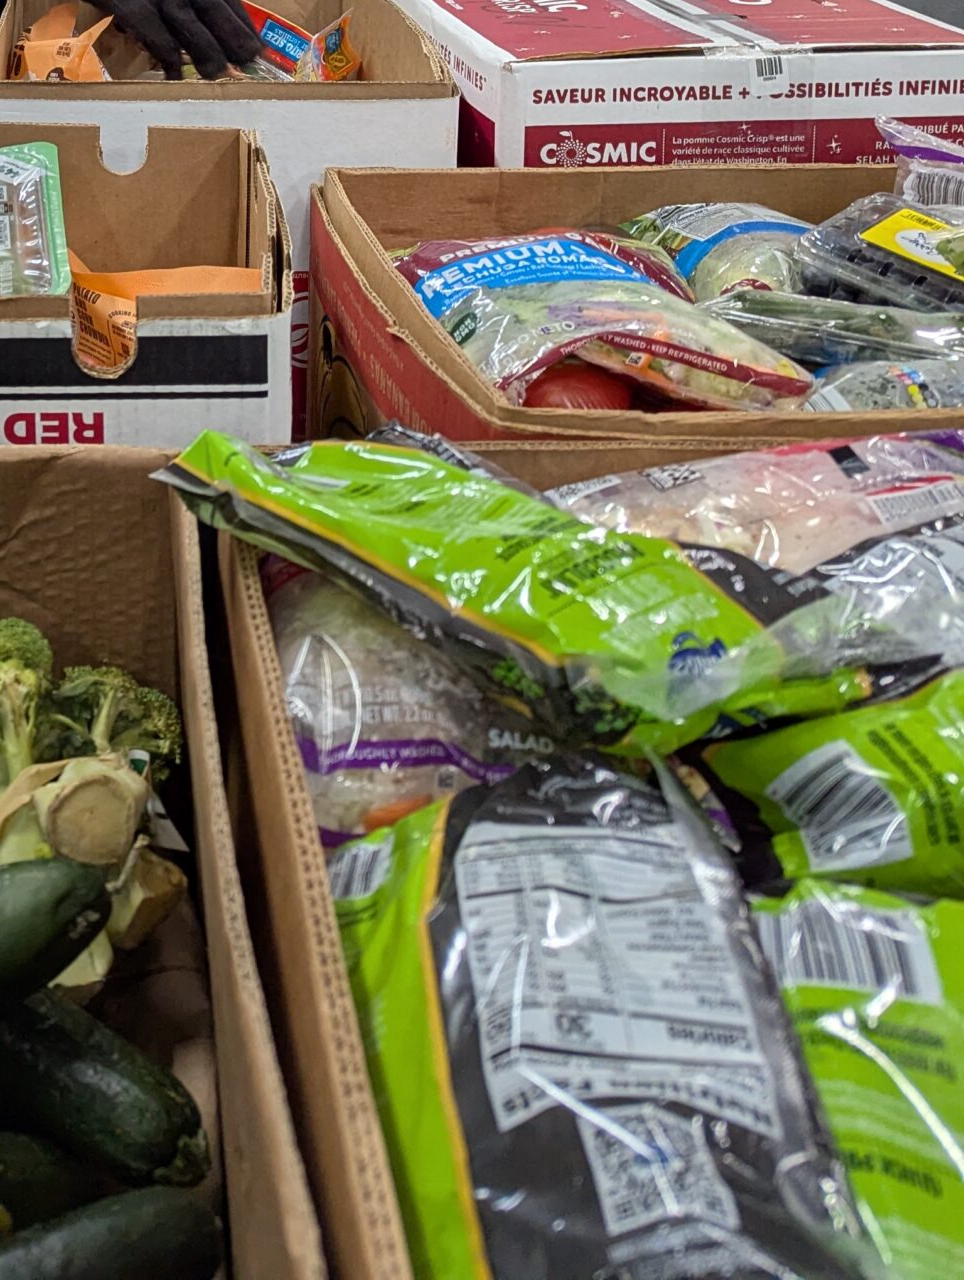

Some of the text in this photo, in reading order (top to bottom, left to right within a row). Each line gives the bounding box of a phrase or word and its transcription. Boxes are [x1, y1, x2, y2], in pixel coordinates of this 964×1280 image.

[265, 31, 286, 48] SIZE
[532, 87, 607, 105] SAVEUR
[611, 85, 733, 103] INCROYABLE
[756, 78, 893, 100] SSIBILITIÉS
[540, 130, 657, 167] COSMIC
[672, 136, 682, 144] La
[683, 138, 715, 146] pomme
[716, 135, 746, 144] Cosmic
[672, 146, 701, 155] variété
[702, 146, 713, 154] de
[733, 145, 771, 156] classique
[772, 145, 805, 153] cultivée
[613, 336, 646, 350] WASHED
[651, 344, 668, 354] KEEP
[668, 348, 728, 372] REFRIGERATED
[4, 412, 105, 445] RED
[488, 727, 555, 753] SALAD
